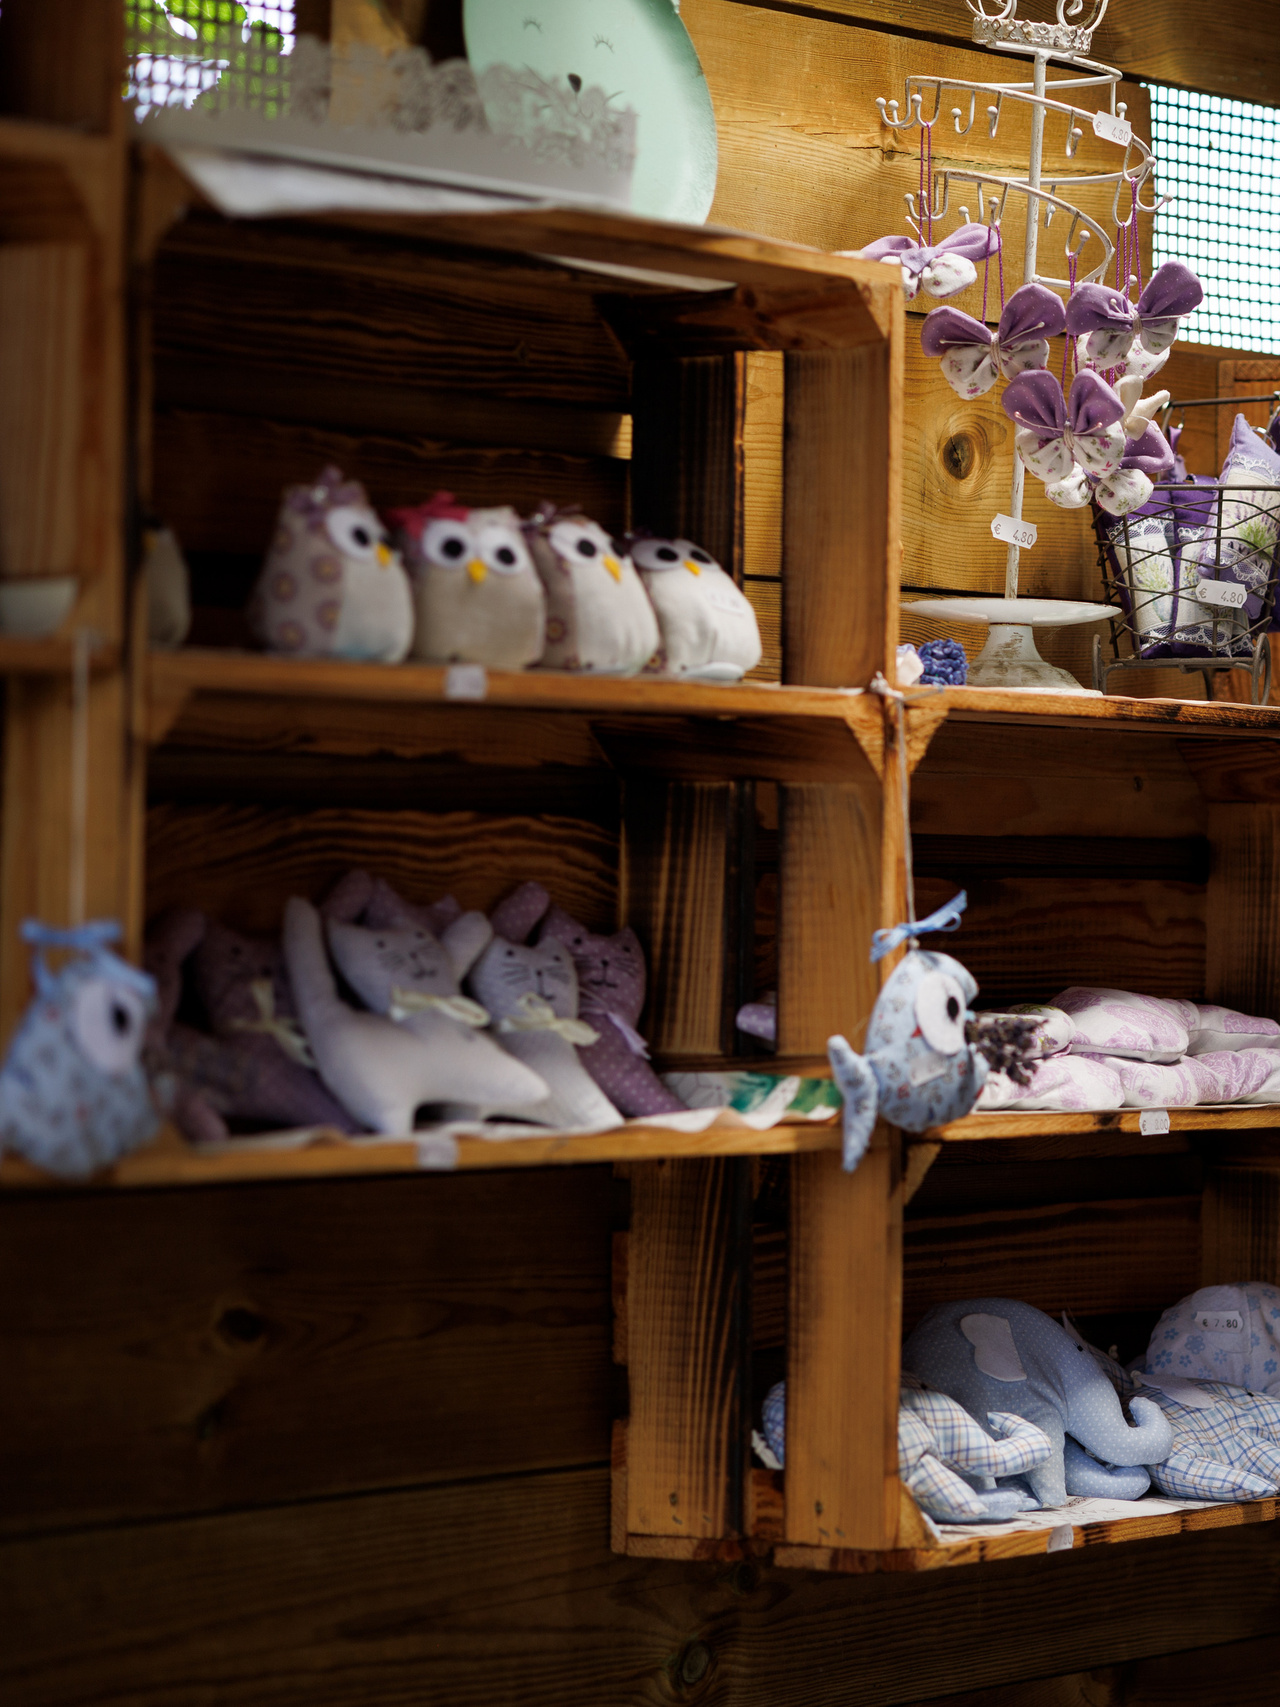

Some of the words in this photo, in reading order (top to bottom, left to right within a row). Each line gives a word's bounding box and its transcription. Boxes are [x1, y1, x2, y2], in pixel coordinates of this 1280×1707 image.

[1096, 121, 1102, 132] €
[1111, 126, 1129, 143] 4.80
[993, 523, 1002, 535] €
[1012, 529, 1034, 545] 4.80
[1198, 587, 1207, 599] €
[1220, 590, 1244, 605] 4.80
[1202, 1318, 1208, 1328] €
[1214, 1319, 1238, 1329] 7.80
